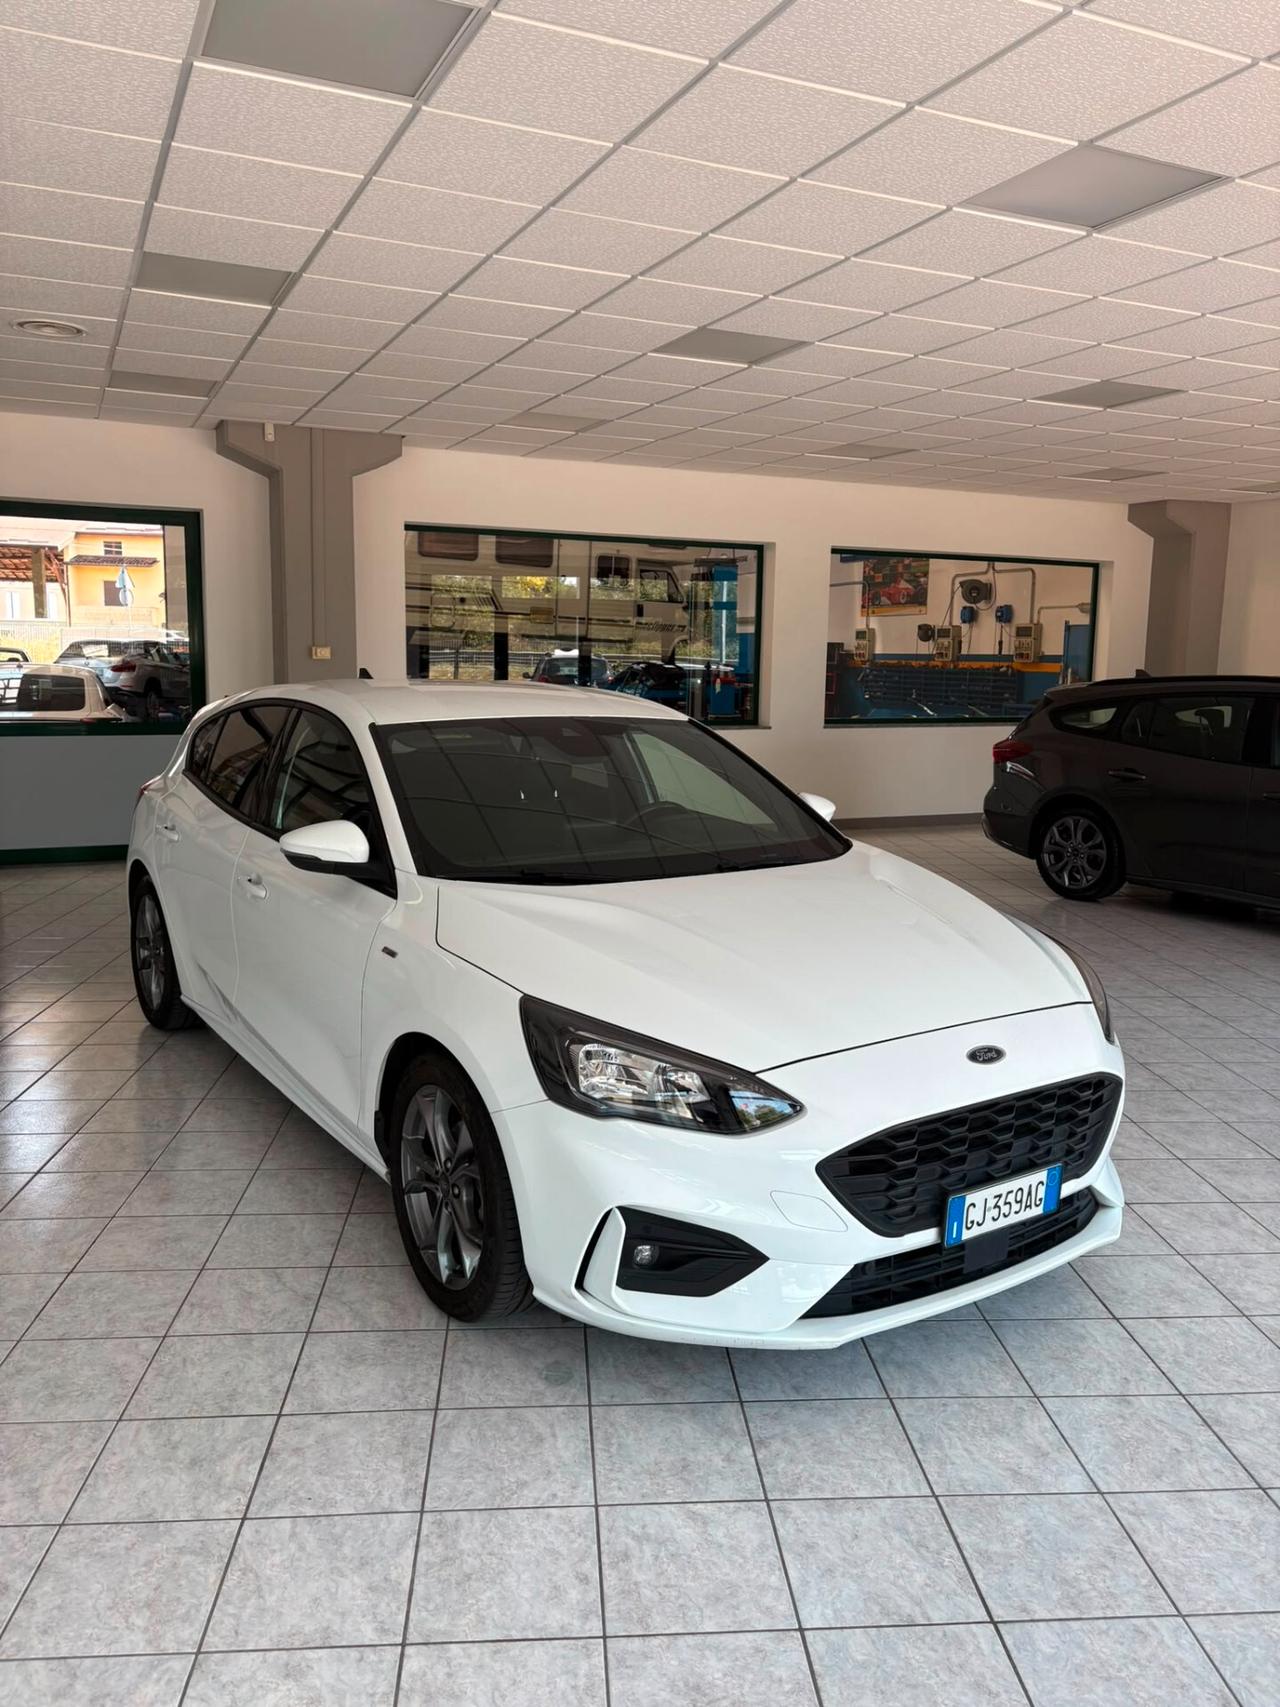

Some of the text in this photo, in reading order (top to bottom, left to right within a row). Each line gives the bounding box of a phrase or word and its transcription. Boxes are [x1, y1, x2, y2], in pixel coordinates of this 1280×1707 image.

[975, 1048, 997, 1061] Ford
[965, 1180, 1045, 1231] GJ359AG
[952, 1221, 958, 1238] I
